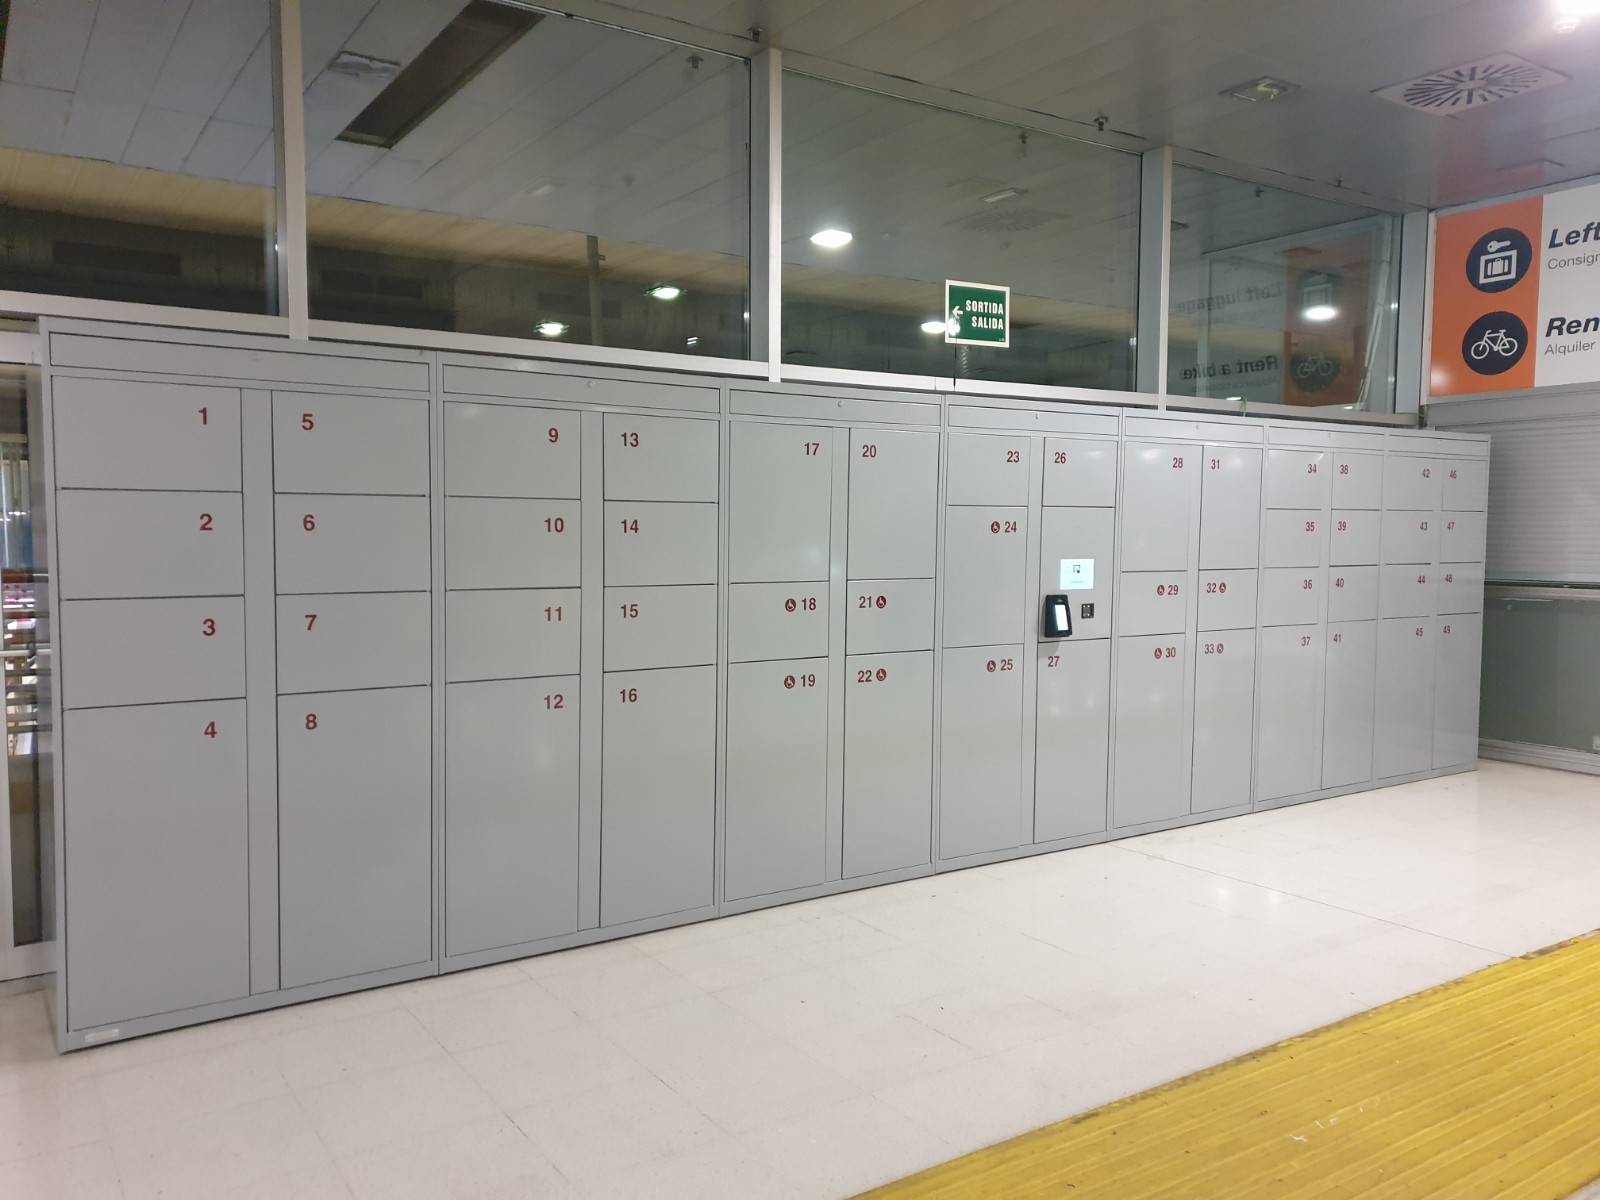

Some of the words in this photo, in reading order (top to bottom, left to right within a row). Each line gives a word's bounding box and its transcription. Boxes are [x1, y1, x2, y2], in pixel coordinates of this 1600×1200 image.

[1548, 221, 1600, 249] Left
[965, 299, 1004, 315] SORTIDA
[971, 315, 1004, 330] SALIDA
[1544, 340, 1596, 356] Alquiler
[198, 407, 208, 425] 1
[301, 413, 314, 431] 5
[548, 427, 559, 444] 9
[620, 432, 639, 448] 13
[804, 442, 820, 456] 17
[862, 444, 877, 458] 20
[1006, 450, 1020, 464] 23
[1054, 451, 1067, 465] 26
[1172, 456, 1184, 469] 28
[1210, 458, 1220, 470] 31
[1307, 463, 1317, 474] 34
[1339, 464, 1349, 475] 38
[199, 513, 213, 531] 2
[302, 514, 316, 532] 6
[544, 517, 565, 533] 10
[620, 518, 640, 534] 14
[1004, 520, 1018, 534] 24
[1305, 521, 1315, 532] 35
[1337, 520, 1347, 532] 39
[1206, 582, 1217, 594] 32
[1303, 579, 1313, 590] 36
[1335, 577, 1345, 588] 40
[1167, 584, 1179, 597] 29
[801, 597, 817, 611] 18
[858, 595, 872, 609] 21
[544, 606, 562, 622] 11
[620, 603, 639, 619] 15
[202, 618, 216, 637] 3
[304, 614, 318, 631] 7
[1301, 636, 1311, 647] 37
[1333, 633, 1342, 643] 41
[1165, 646, 1177, 659] 30
[1204, 643, 1215, 655] 33
[1000, 658, 1014, 672] 25
[1047, 655, 1060, 668] 27
[800, 673, 816, 688] 19
[857, 669, 873, 684] 22
[543, 693, 564, 710] 12
[619, 687, 638, 704] 16
[305, 713, 318, 731] 8
[203, 721, 218, 739] 4
